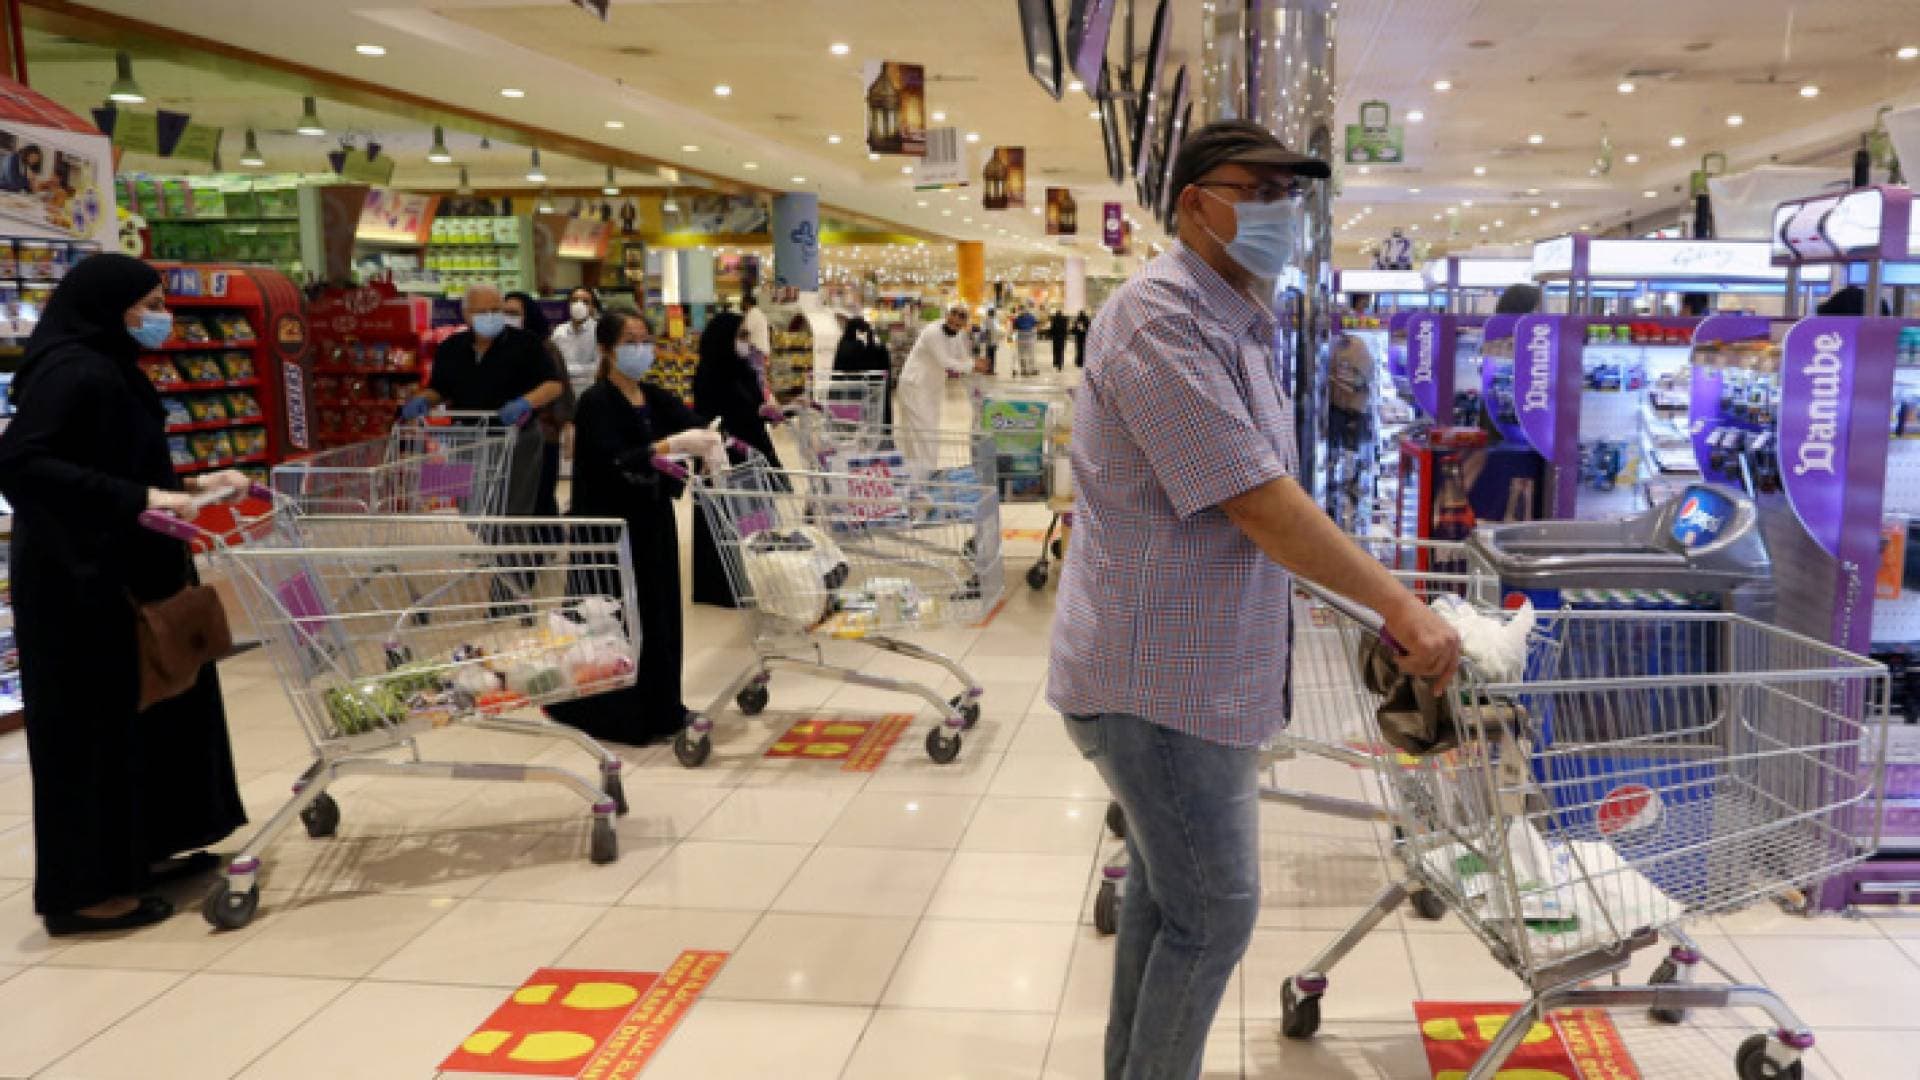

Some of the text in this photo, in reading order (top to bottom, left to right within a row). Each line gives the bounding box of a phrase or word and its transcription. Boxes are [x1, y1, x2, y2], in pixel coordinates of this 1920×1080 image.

[1414, 319, 1434, 385] Danube
[1523, 323, 1551, 412] Danube
[1793, 331, 1843, 477] Danube
